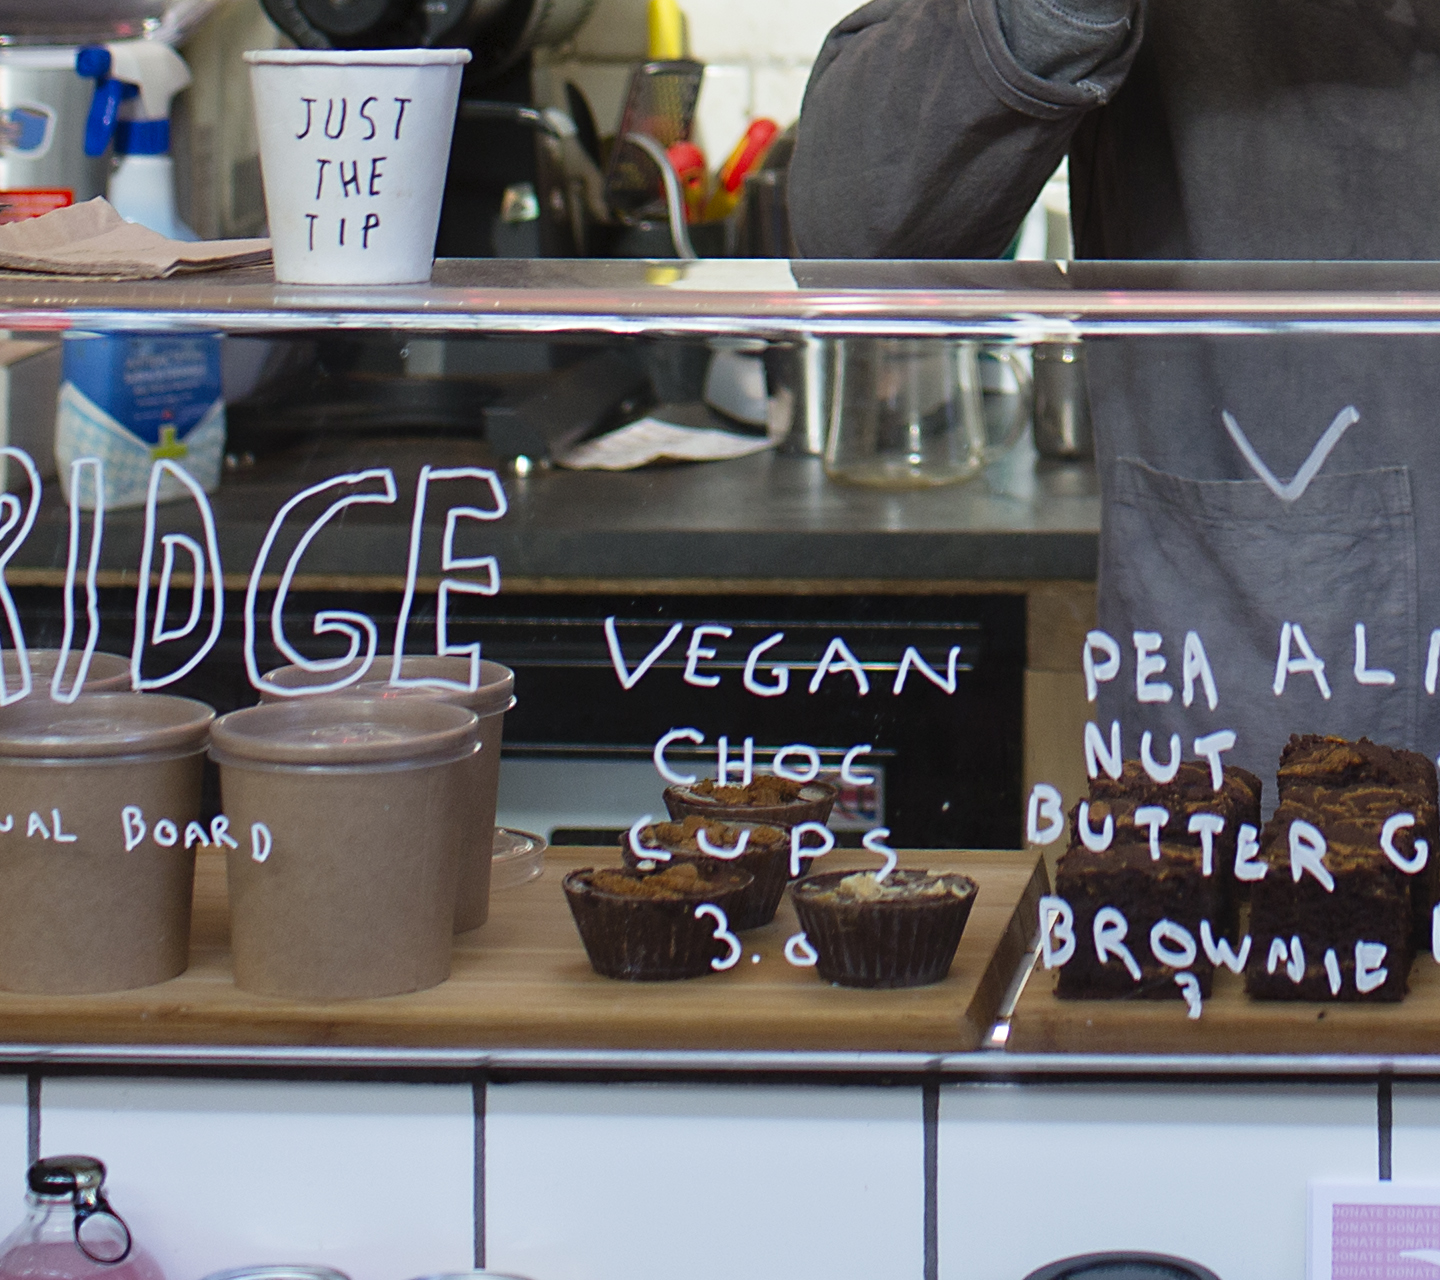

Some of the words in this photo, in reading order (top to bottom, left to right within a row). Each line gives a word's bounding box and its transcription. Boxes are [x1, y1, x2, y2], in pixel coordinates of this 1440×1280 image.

[294, 96, 411, 142] JUST
[314, 157, 385, 198] THE
[303, 213, 382, 253] TIP
[604, 615, 960, 696] VEGAN
[1083, 630, 1220, 711] PEA
[654, 727, 875, 787] CHOC
[1083, 720, 1238, 791] NUT
[120, 802, 275, 862] BOARD
[628, 815, 900, 882] CUPS
[1026, 785, 1337, 892] BUTTER
[1040, 895, 1389, 995] BROWNIE
[1387, 1207, 1439, 1220] DONATE
